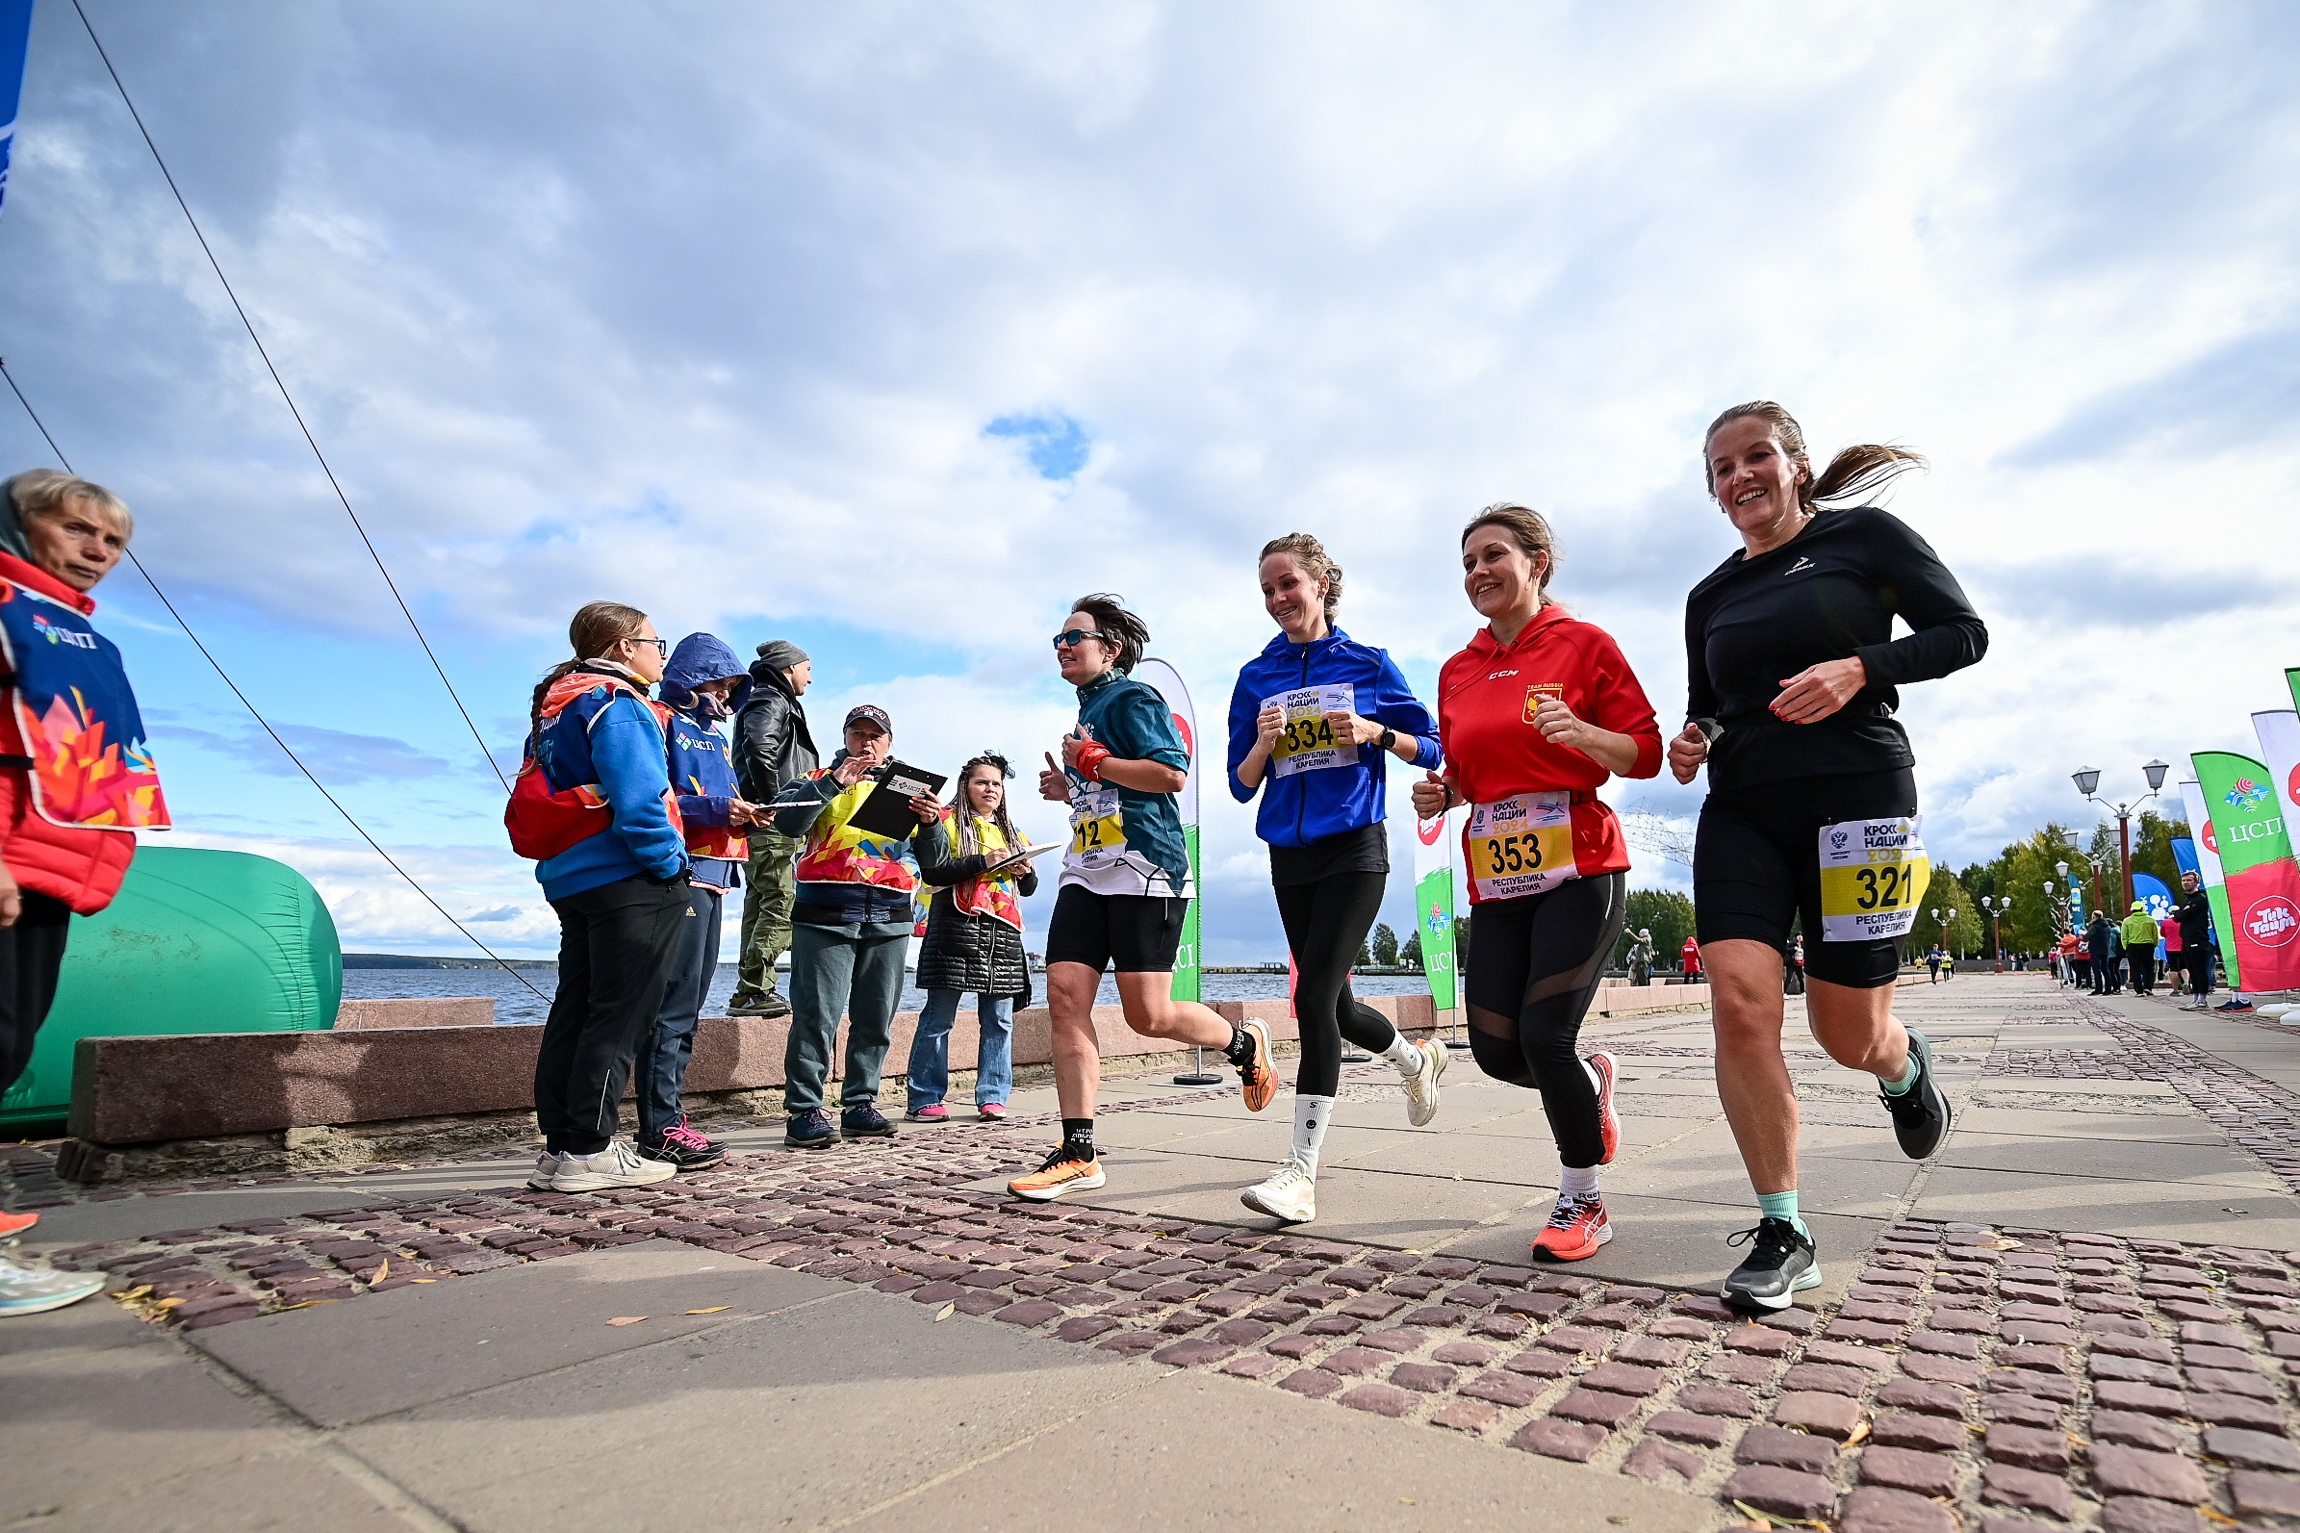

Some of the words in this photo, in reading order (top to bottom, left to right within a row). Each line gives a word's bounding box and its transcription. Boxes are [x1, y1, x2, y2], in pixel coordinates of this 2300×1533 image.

[1488, 669, 1519, 681] CCM
[1287, 698, 1320, 709] НАЦИИ
[1289, 706, 1322, 718] 2024
[1285, 719, 1334, 753] 334
[691, 738, 716, 752] ЦСП
[1288, 749, 1337, 764] РЕСПУБЛИКА
[1295, 758, 1330, 770] КАРЕЛИЯ
[1491, 808, 1527, 823] НАЦИИ
[1493, 818, 1529, 835] 2024
[2229, 816, 2283, 843] ЦСП
[1864, 834, 1908, 849] НАЦИИ
[1488, 833, 1542, 874] 353
[1492, 873, 1547, 887] РЕСПУБЛИКА
[1856, 863, 1912, 910] 321
[1500, 882, 1541, 895] КАРЕЛИЯ
[1856, 909, 1912, 926] РЕСПУБЛИКА
[1868, 921, 1906, 935] КАРЕЛИЯ
